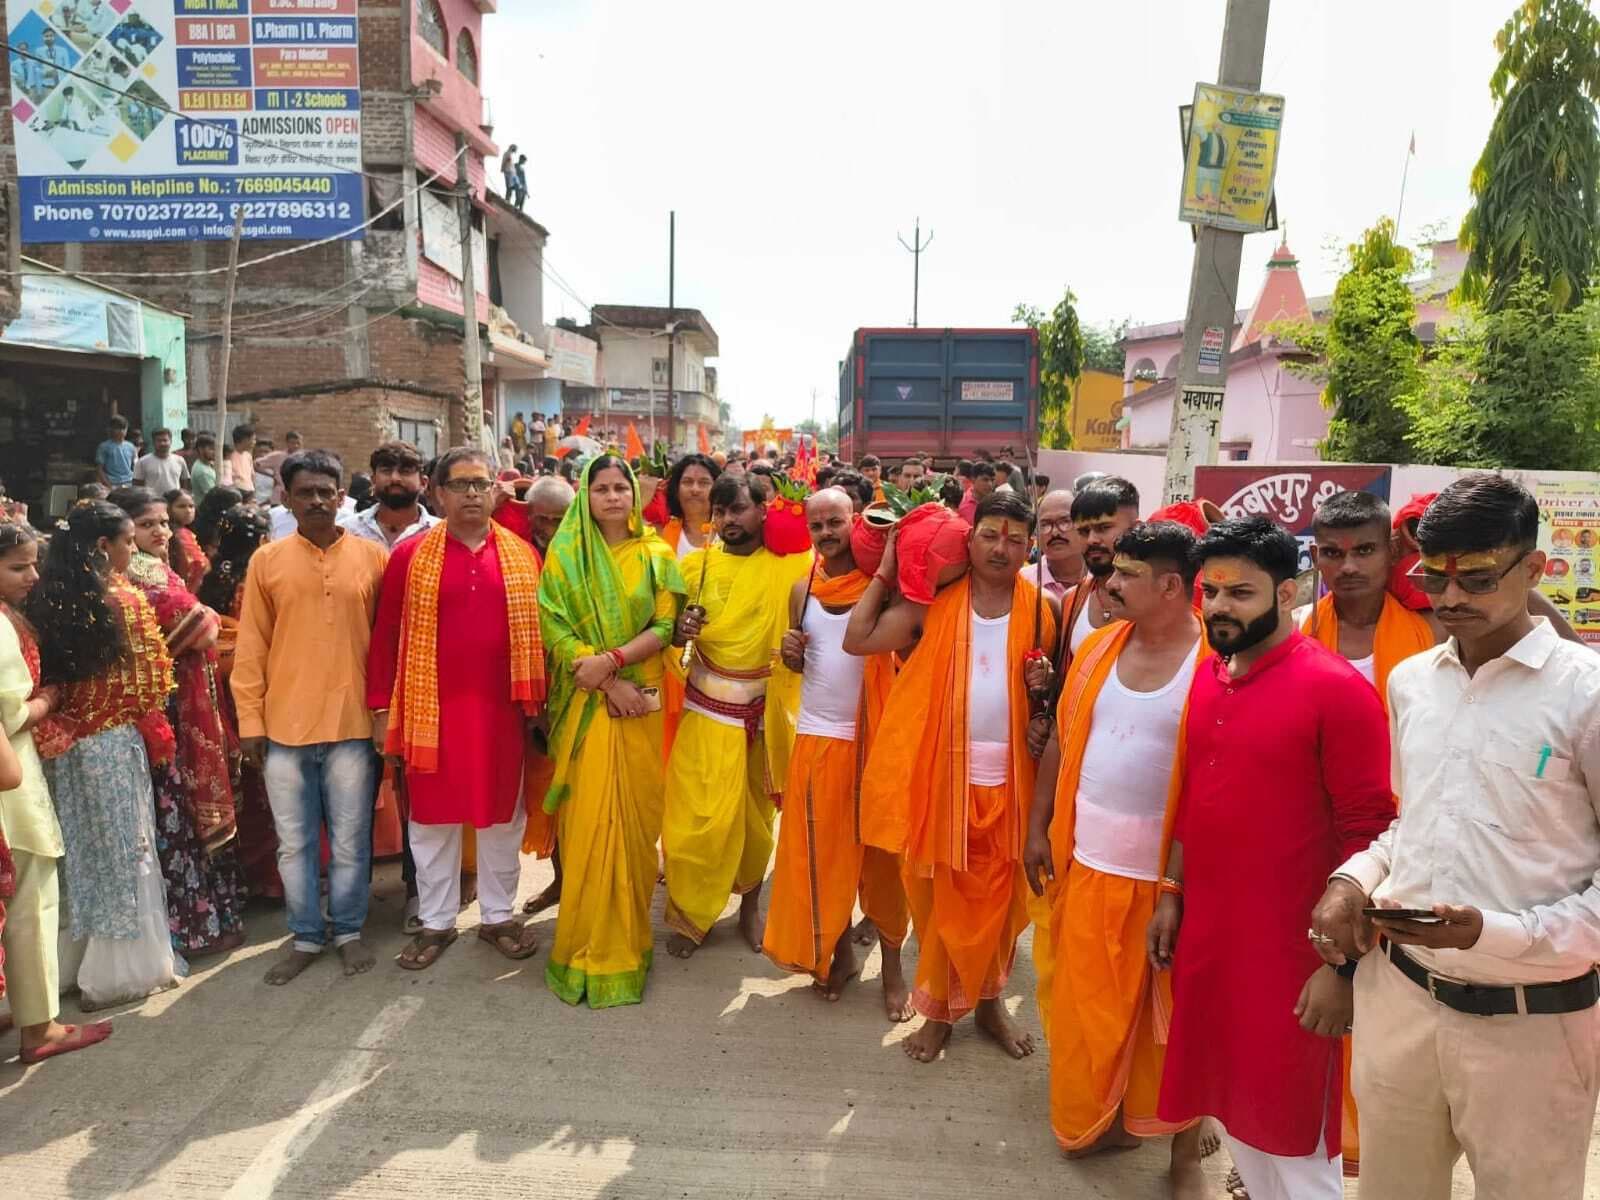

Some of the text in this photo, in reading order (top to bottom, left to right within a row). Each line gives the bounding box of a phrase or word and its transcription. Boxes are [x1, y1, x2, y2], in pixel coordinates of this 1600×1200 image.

[188, 24, 236, 40] BBA BCA
[255, 23, 299, 39] B.Pharm
[319, 23, 353, 39] Pharm
[192, 51, 236, 65] Polytechnic
[304, 91, 347, 108] Schools
[242, 117, 358, 135] ADMISSIONS OPEN
[180, 123, 234, 149] 100%
[183, 150, 229, 161] PLACEMENT
[48, 177, 331, 198] Admission Helpline No.: 7669045440
[33, 204, 94, 221] Phone
[100, 202, 224, 222] 7070237222,
[1538, 497, 1585, 507] Driver
